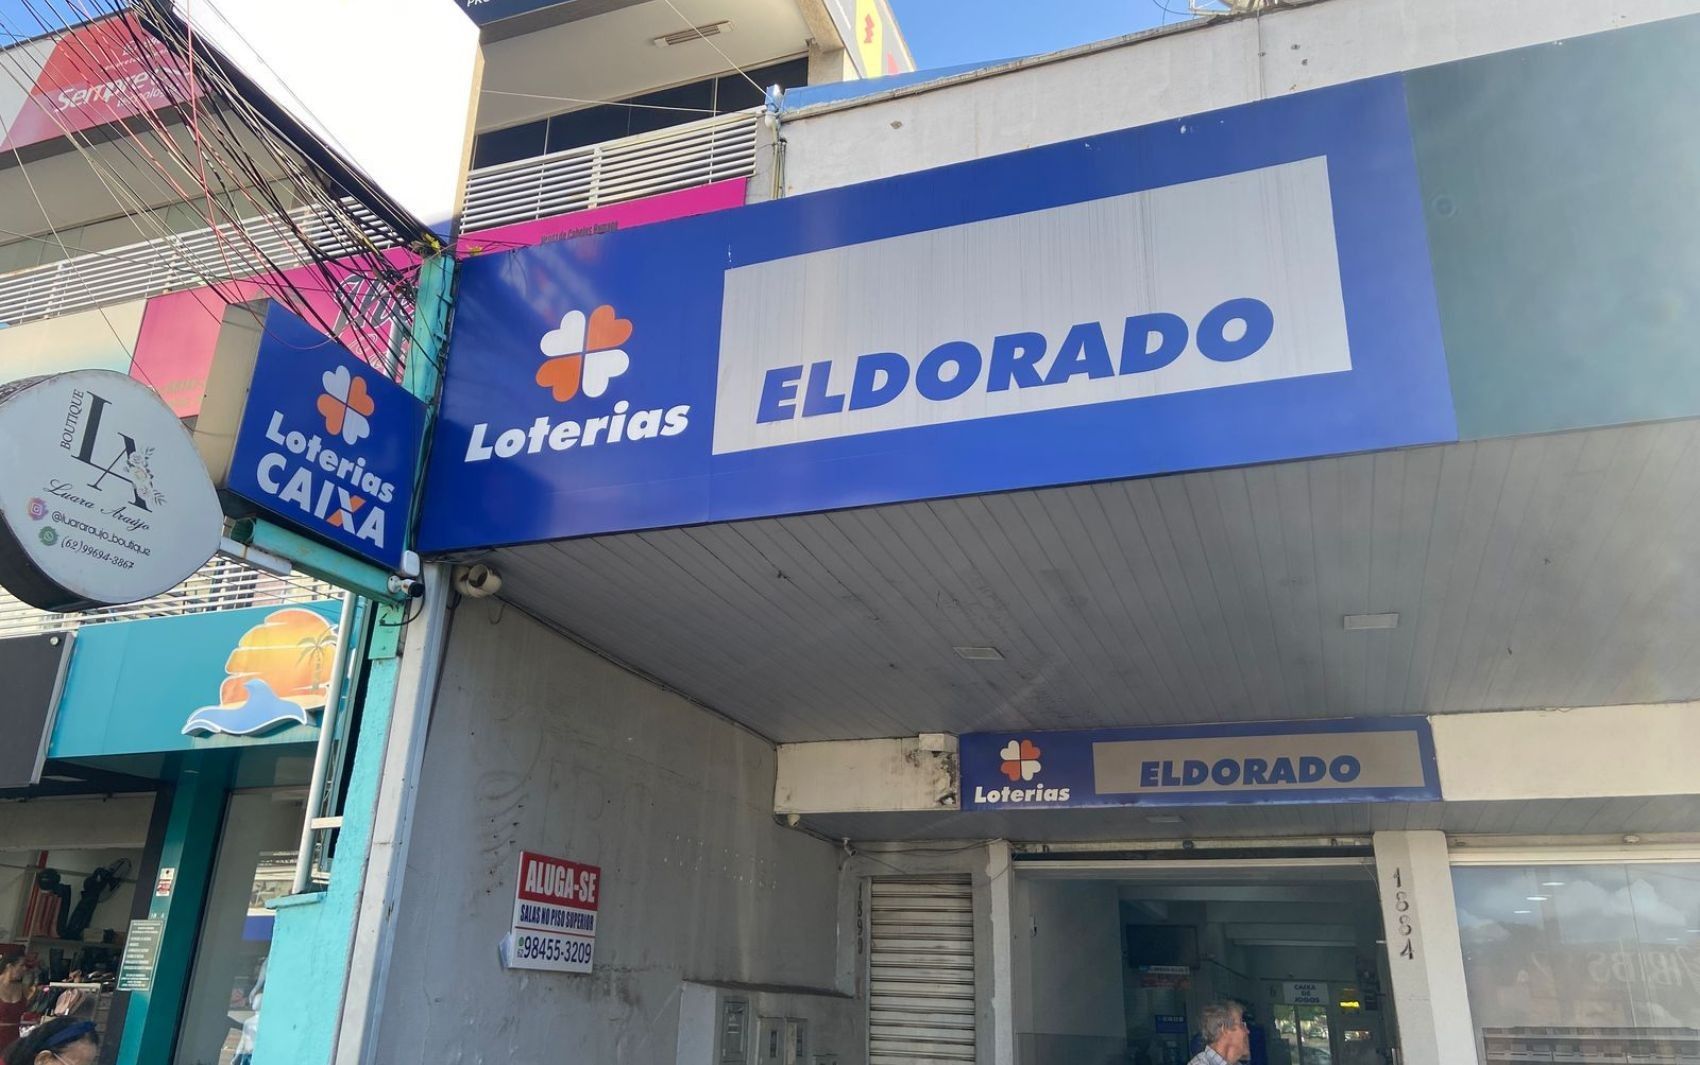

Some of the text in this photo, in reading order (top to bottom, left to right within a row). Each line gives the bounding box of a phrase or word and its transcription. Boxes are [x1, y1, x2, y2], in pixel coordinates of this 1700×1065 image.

[756, 297, 1274, 424] ELDORADO
[60, 389, 84, 450] BOUTIQUE
[464, 400, 690, 462] Loterias
[265, 410, 395, 503] Loterias
[43, 479, 95, 509] Luara
[257, 452, 385, 549] CAIXA
[974, 783, 1070, 803] Loterias
[1140, 755, 1361, 788] ELDORADO
[525, 860, 597, 903] ALUGA-SE
[520, 904, 594, 931] SALAS NO PISO SUPERIOR
[523, 935, 592, 964] 98455-3209
